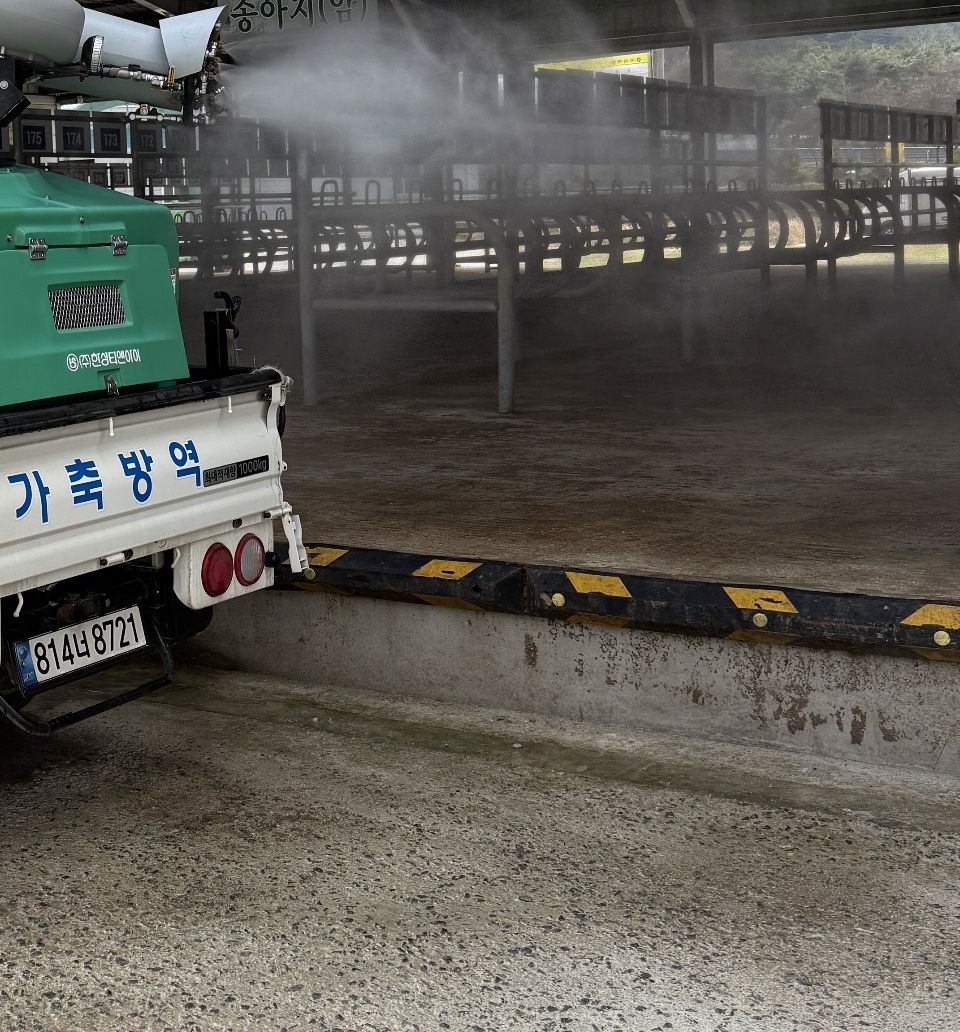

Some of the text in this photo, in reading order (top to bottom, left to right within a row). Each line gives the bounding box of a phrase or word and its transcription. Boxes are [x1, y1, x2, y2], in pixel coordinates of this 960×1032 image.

[26, 131, 43, 145] 175
[66, 132, 82, 146] 174
[104, 134, 118, 147] 173
[238, 458, 267, 475] 1000kg
